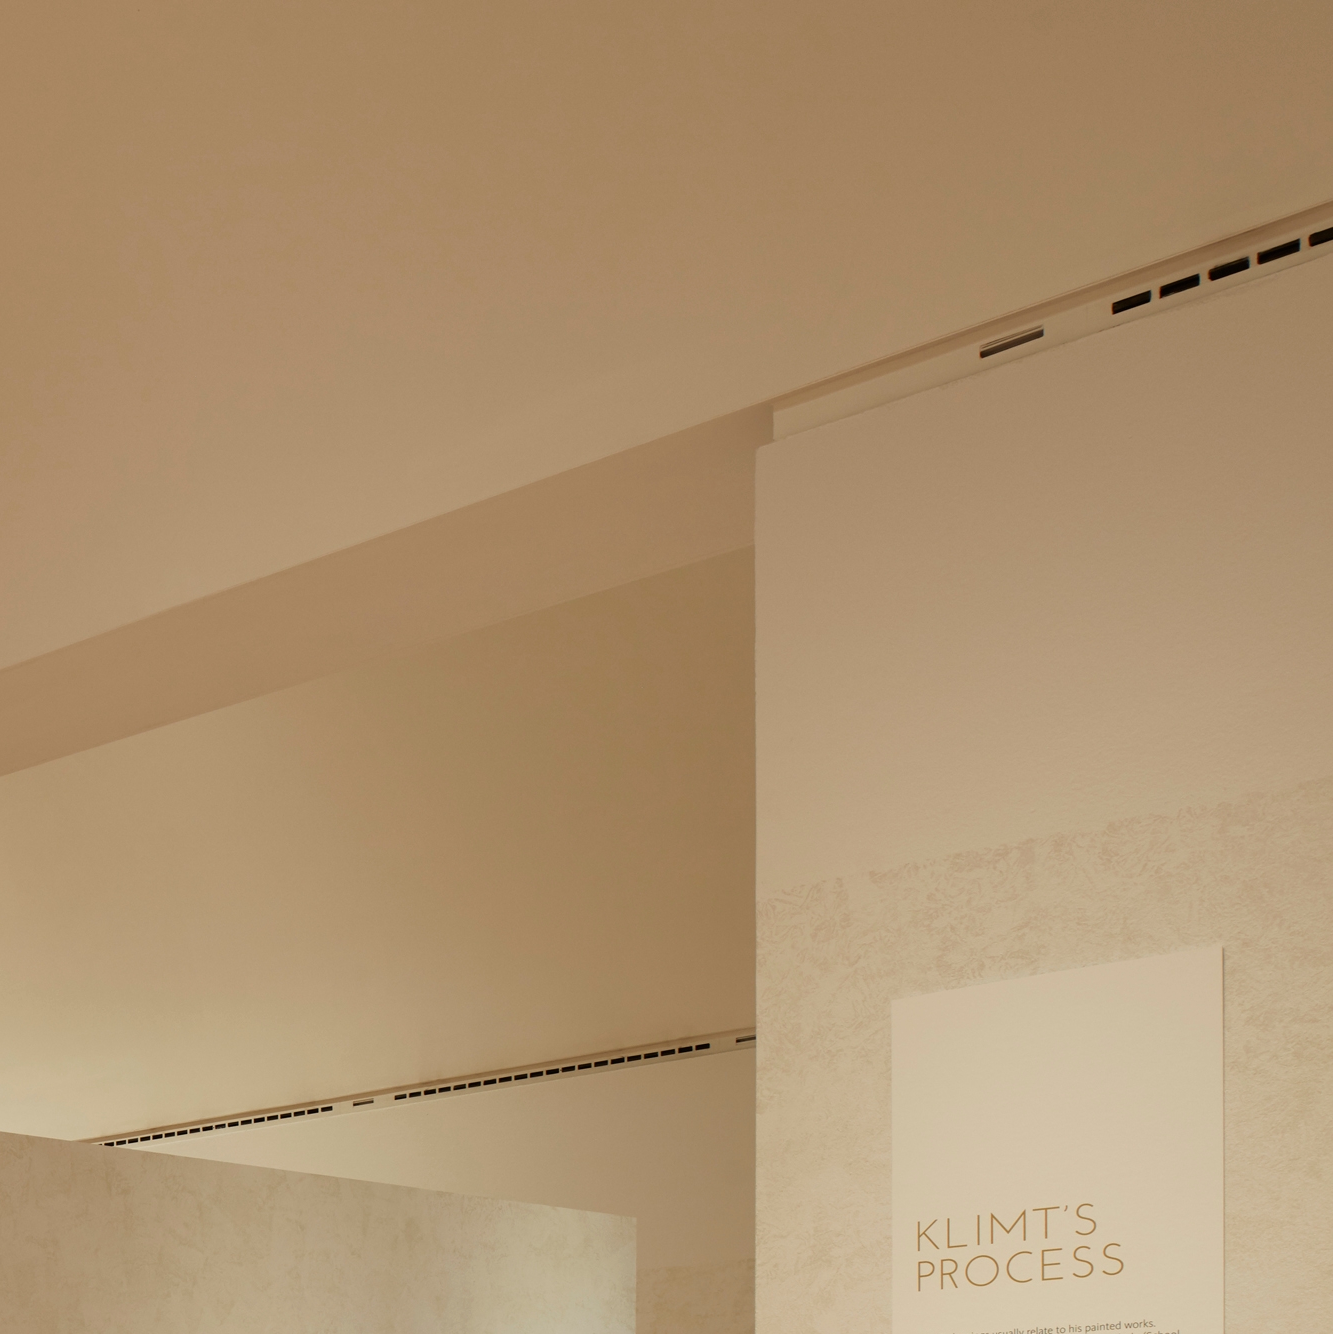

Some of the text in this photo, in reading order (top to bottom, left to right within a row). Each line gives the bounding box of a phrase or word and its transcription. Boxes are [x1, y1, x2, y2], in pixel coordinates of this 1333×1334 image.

[917, 1203, 1097, 1252] KLIMT’S
[917, 1243, 1124, 1292] PROCESS
[1027, 1326, 1053, 1334] relate
[1056, 1325, 1066, 1333] to
[1069, 1324, 1082, 1332] his
[1085, 1320, 1121, 1333] painted
